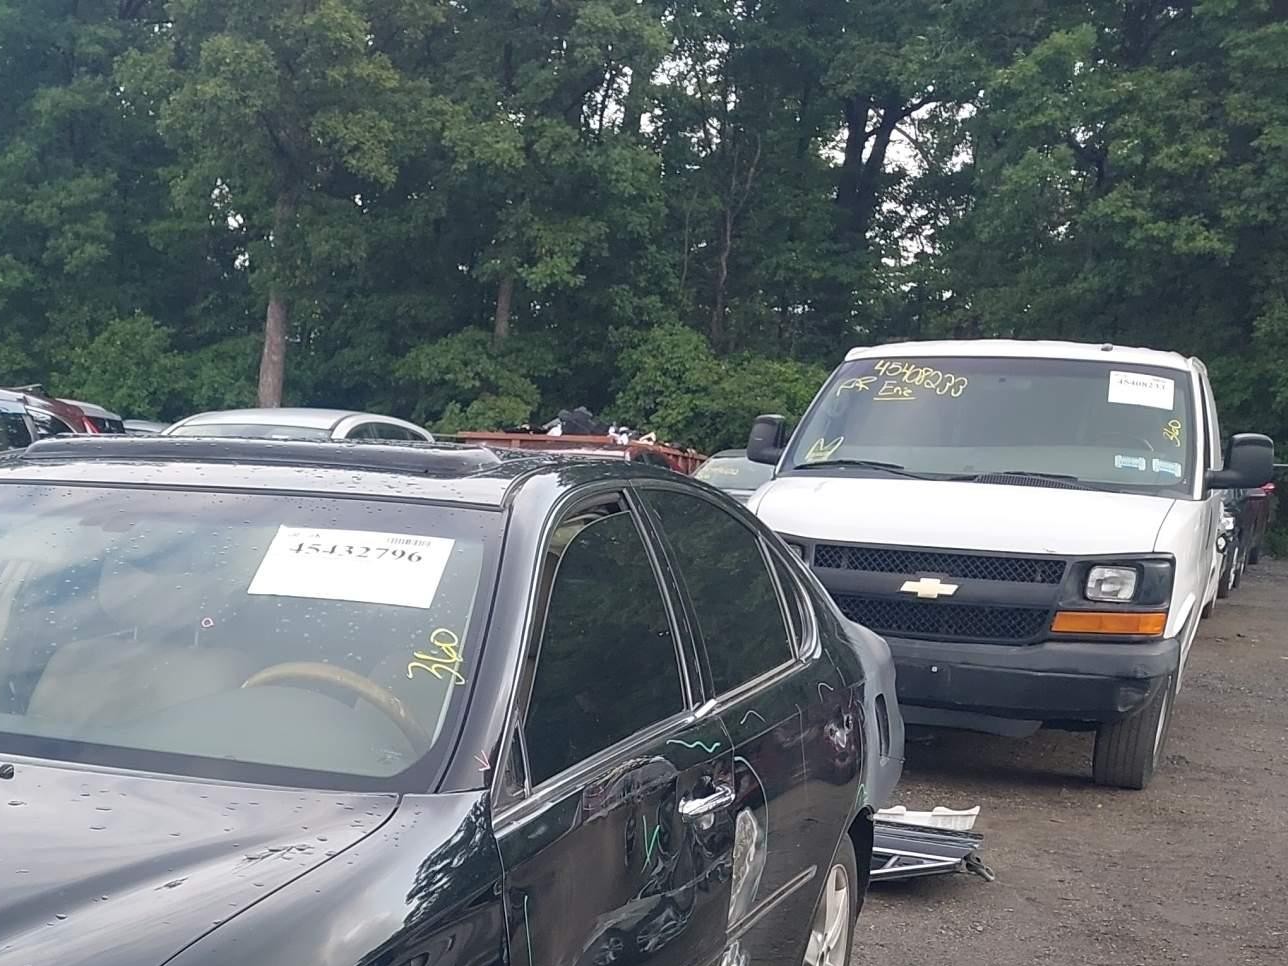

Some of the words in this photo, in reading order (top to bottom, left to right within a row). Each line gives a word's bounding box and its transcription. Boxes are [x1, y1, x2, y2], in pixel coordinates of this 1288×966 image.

[874, 360, 968, 397] 45408233
[1162, 419, 1181, 448] 360
[289, 542, 423, 563] 45432796
[407, 628, 465, 685] 360
